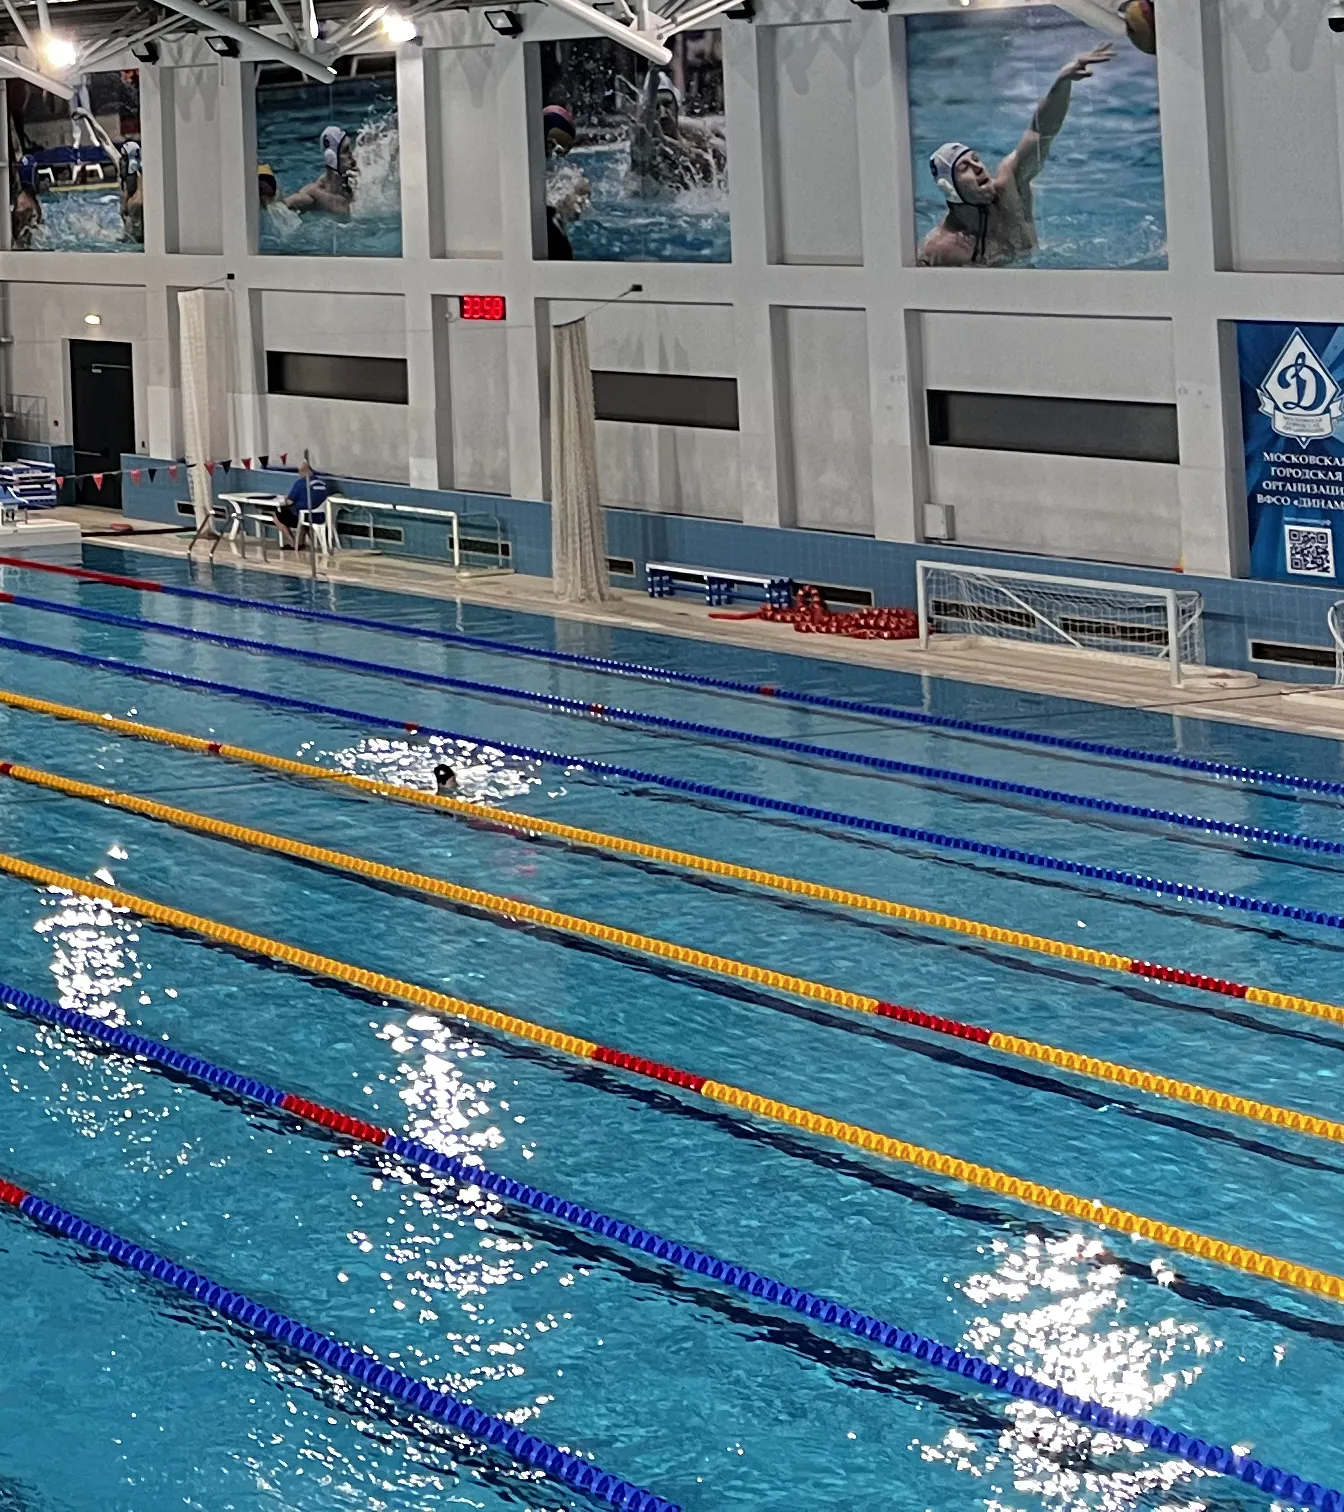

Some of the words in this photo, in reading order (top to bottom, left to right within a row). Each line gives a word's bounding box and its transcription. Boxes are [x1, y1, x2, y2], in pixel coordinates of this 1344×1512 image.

[1270, 467, 1343, 482] ГОРОДСКАЯ
[1262, 480, 1344, 496] ОРГАНИЗАЦИ
[1256, 493, 1291, 506] ВФСО
[1293, 496, 1344, 510] «ДИНАМ
